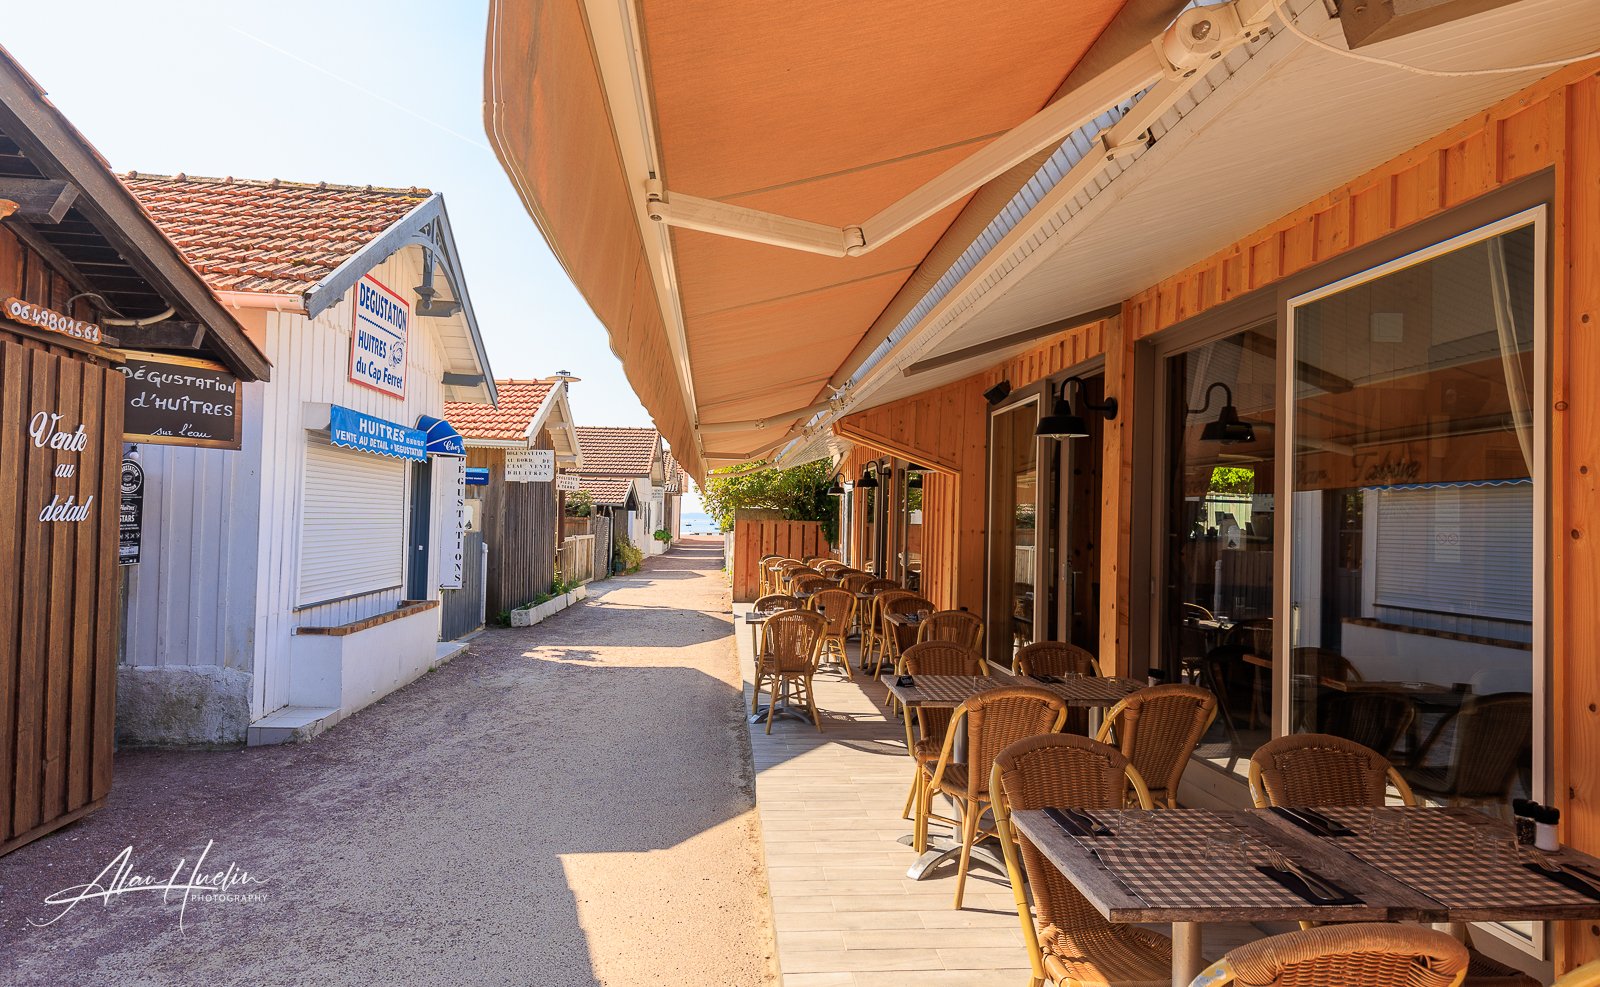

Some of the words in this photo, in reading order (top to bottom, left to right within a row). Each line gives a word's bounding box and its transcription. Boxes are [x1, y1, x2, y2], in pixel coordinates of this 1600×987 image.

[360, 282, 407, 332] DEGUSTATION
[358, 329, 387, 359] HUITRES
[356, 356, 366, 375] du
[368, 360, 382, 385] Cap
[383, 367, 403, 389] Ferret
[29, 411, 88, 452] Vente
[151, 427, 173, 436] sur
[179, 423, 212, 438] l'eau
[335, 429, 358, 444] VENTE
[359, 435, 368, 447] AU
[369, 438, 389, 451] DETAIL
[359, 418, 405, 443] HUITRES
[443, 440, 461, 454] Chez
[55, 463, 75, 478] au
